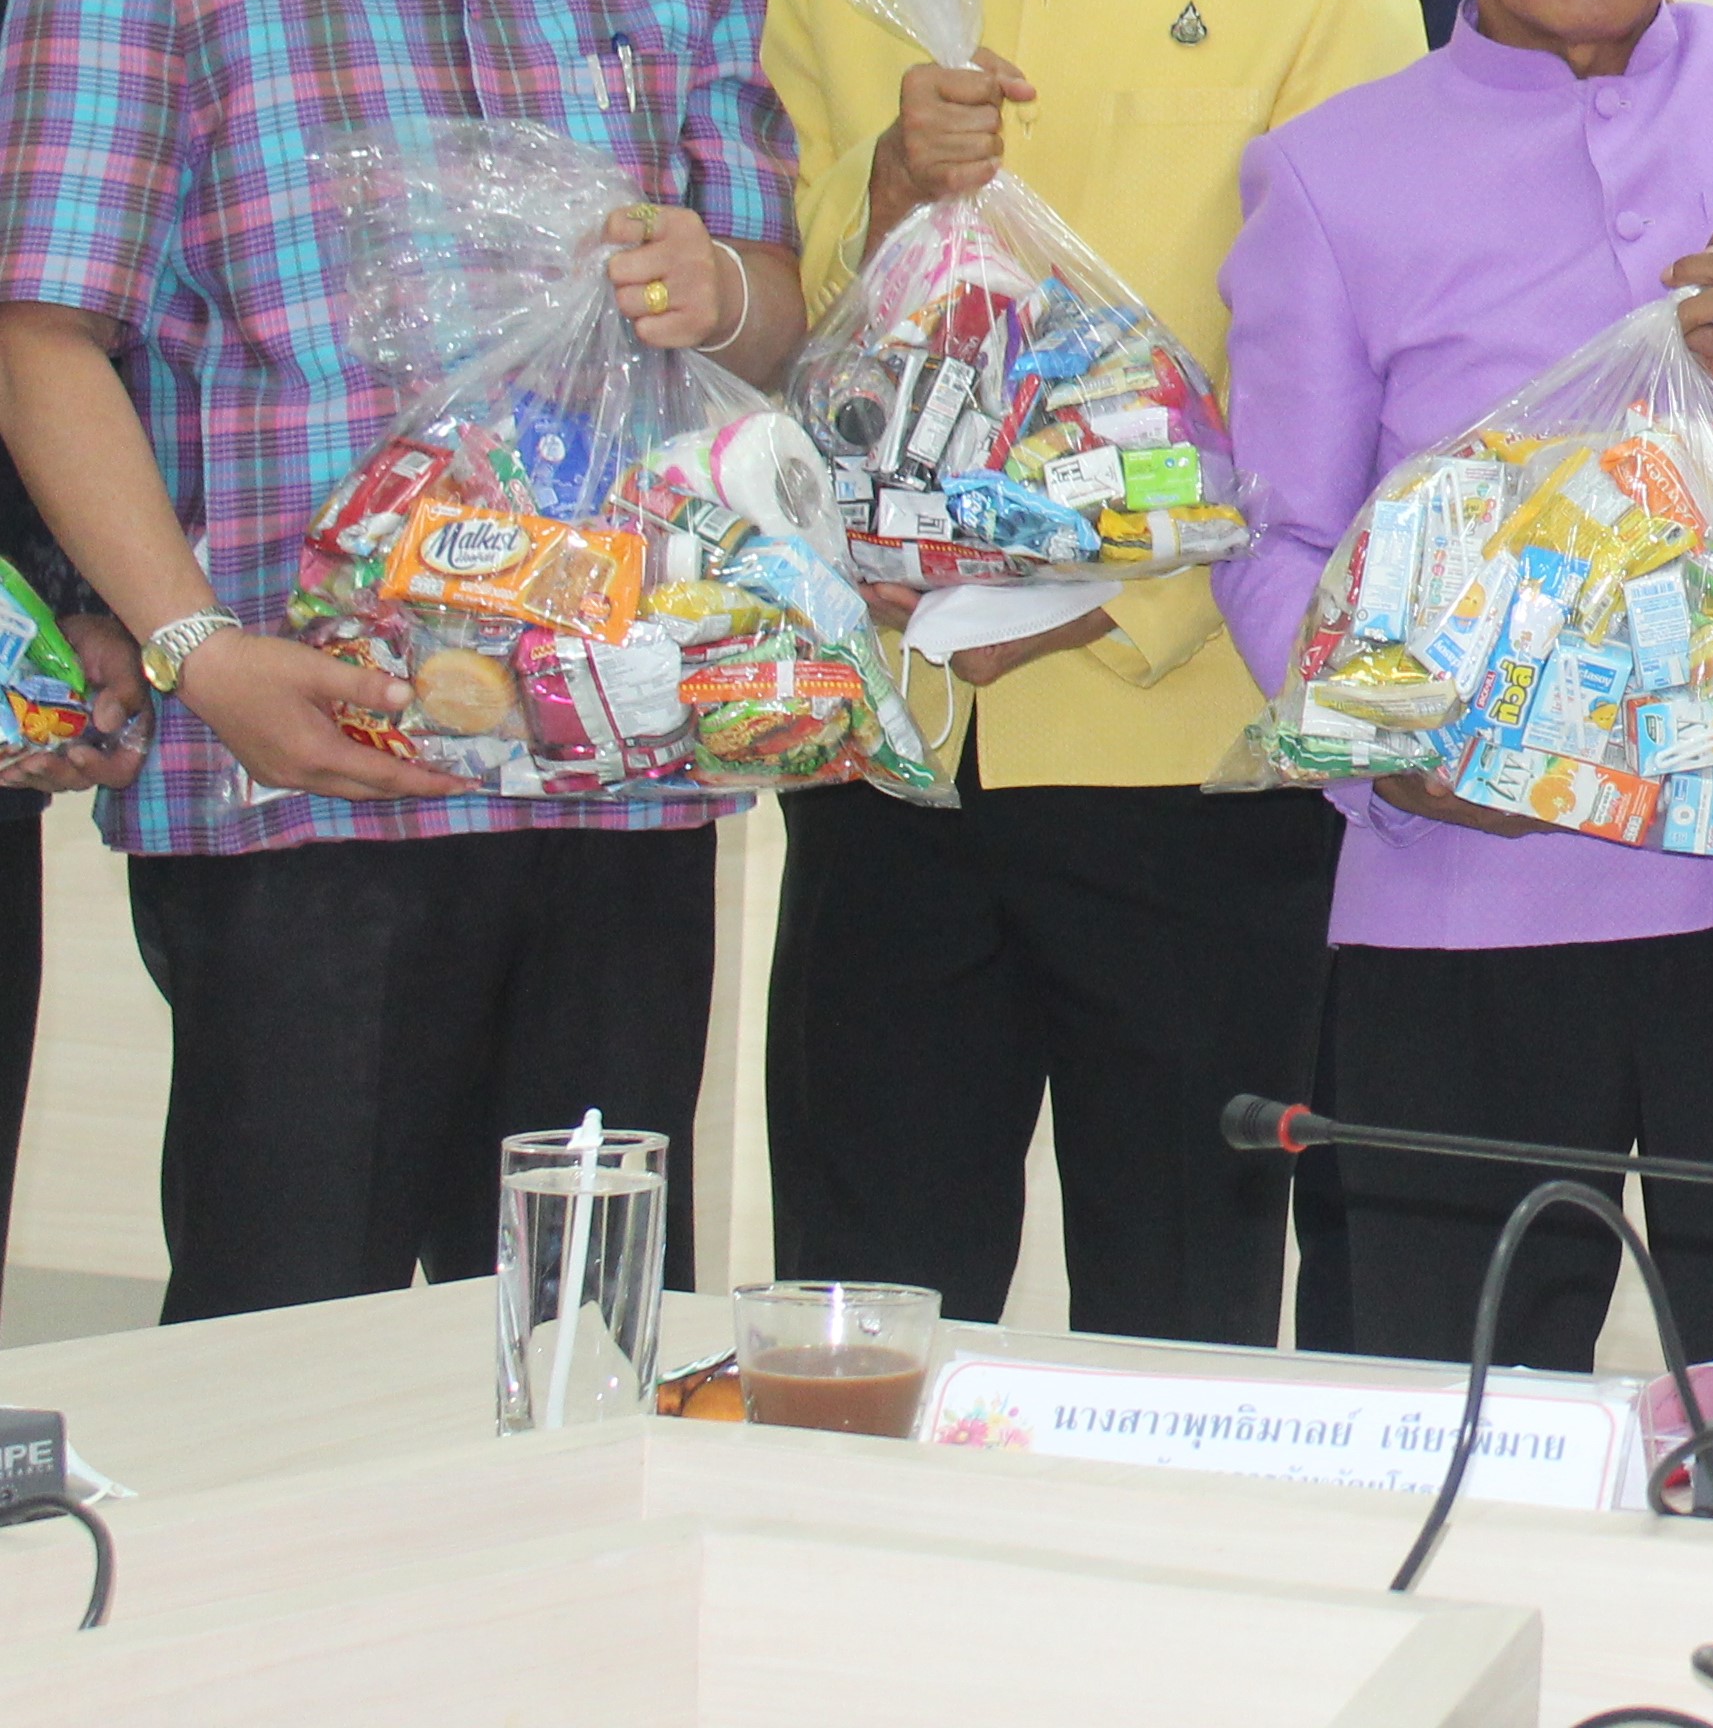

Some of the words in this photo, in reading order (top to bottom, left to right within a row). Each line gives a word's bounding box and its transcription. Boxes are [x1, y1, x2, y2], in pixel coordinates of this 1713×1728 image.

[432, 518, 520, 572] Malkist
[1052, 1404, 1356, 1450] นางสาวพุทธิมาลย์
